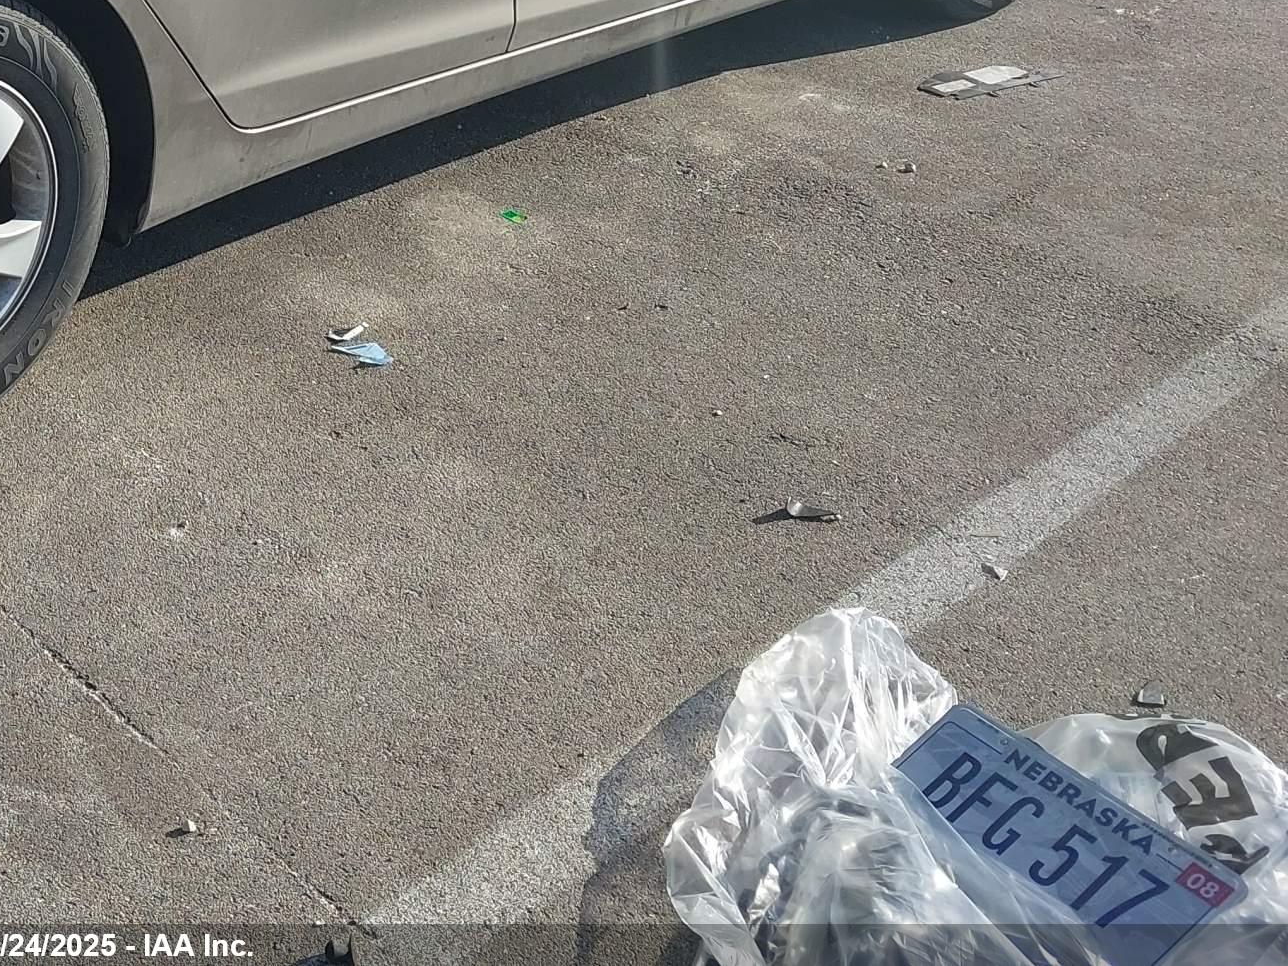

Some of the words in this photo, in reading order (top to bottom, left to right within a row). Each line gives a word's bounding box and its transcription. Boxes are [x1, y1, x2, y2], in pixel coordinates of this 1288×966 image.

[921, 751, 1045, 856] BFG
[1028, 823, 1171, 929] 517
[1003, 748, 1154, 855] NEBRASKA
[1185, 872, 1221, 900] 08
